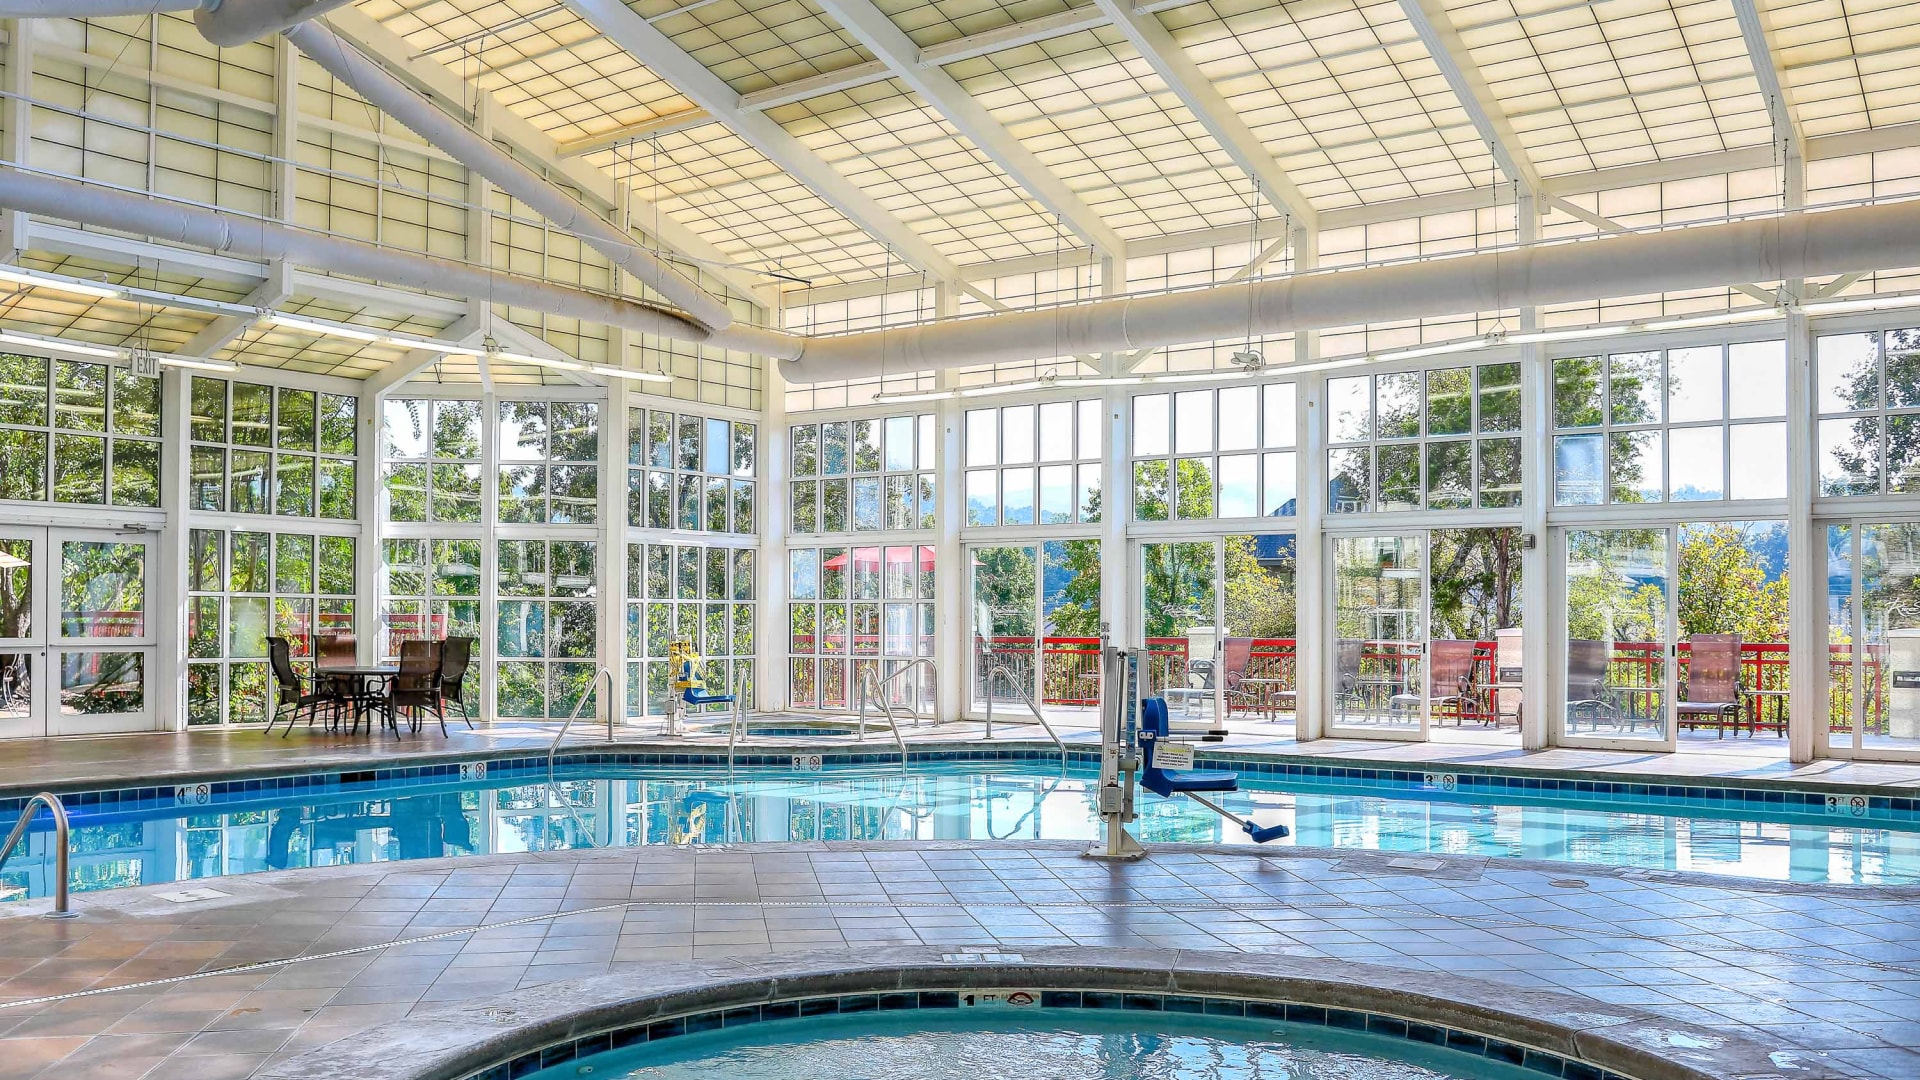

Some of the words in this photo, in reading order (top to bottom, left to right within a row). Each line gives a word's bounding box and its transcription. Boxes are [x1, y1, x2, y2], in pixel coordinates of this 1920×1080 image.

[137, 357, 157, 375] EXIT
[963, 994, 975, 1007] 1
[983, 994, 996, 1002] FT
